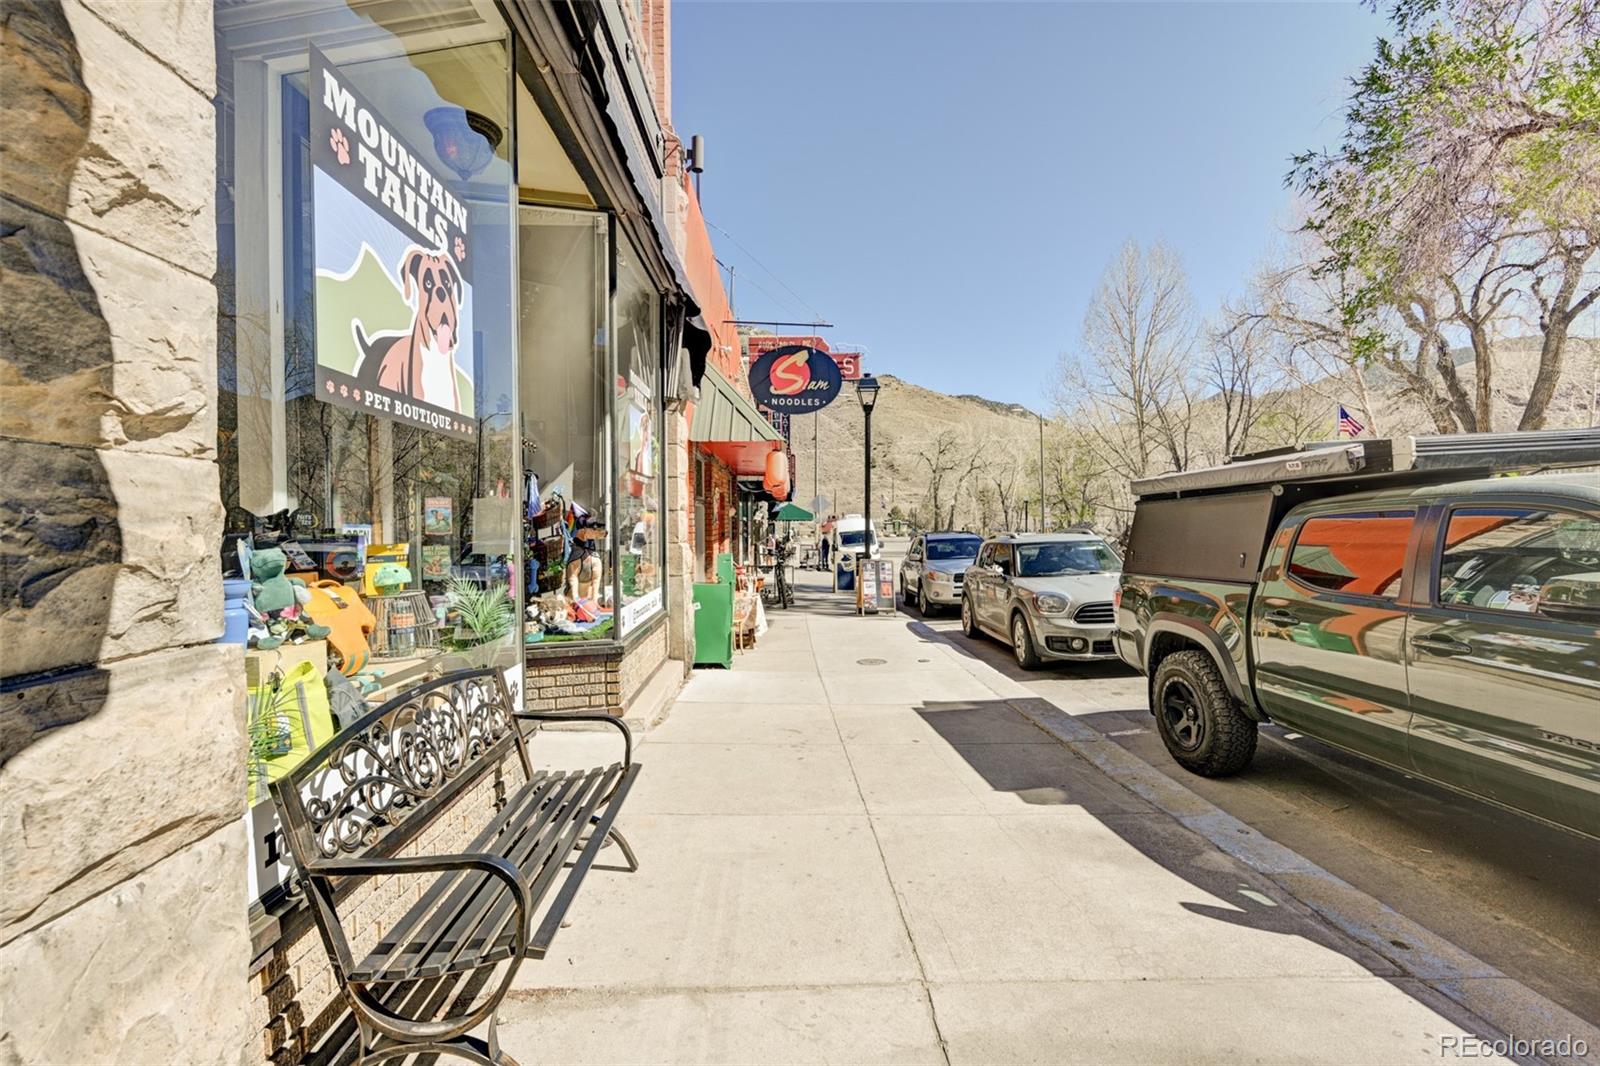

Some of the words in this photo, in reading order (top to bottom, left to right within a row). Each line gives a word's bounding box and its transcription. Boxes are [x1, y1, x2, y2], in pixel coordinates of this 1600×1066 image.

[323, 68, 467, 235] MOUNTAIN
[358, 142, 448, 251] TAILS
[769, 349, 830, 395] Sam
[364, 390, 391, 412] PET
[394, 399, 452, 430] BOUTIQUE
[771, 398, 820, 406] NOODLES
[408, 479, 416, 531] 208
